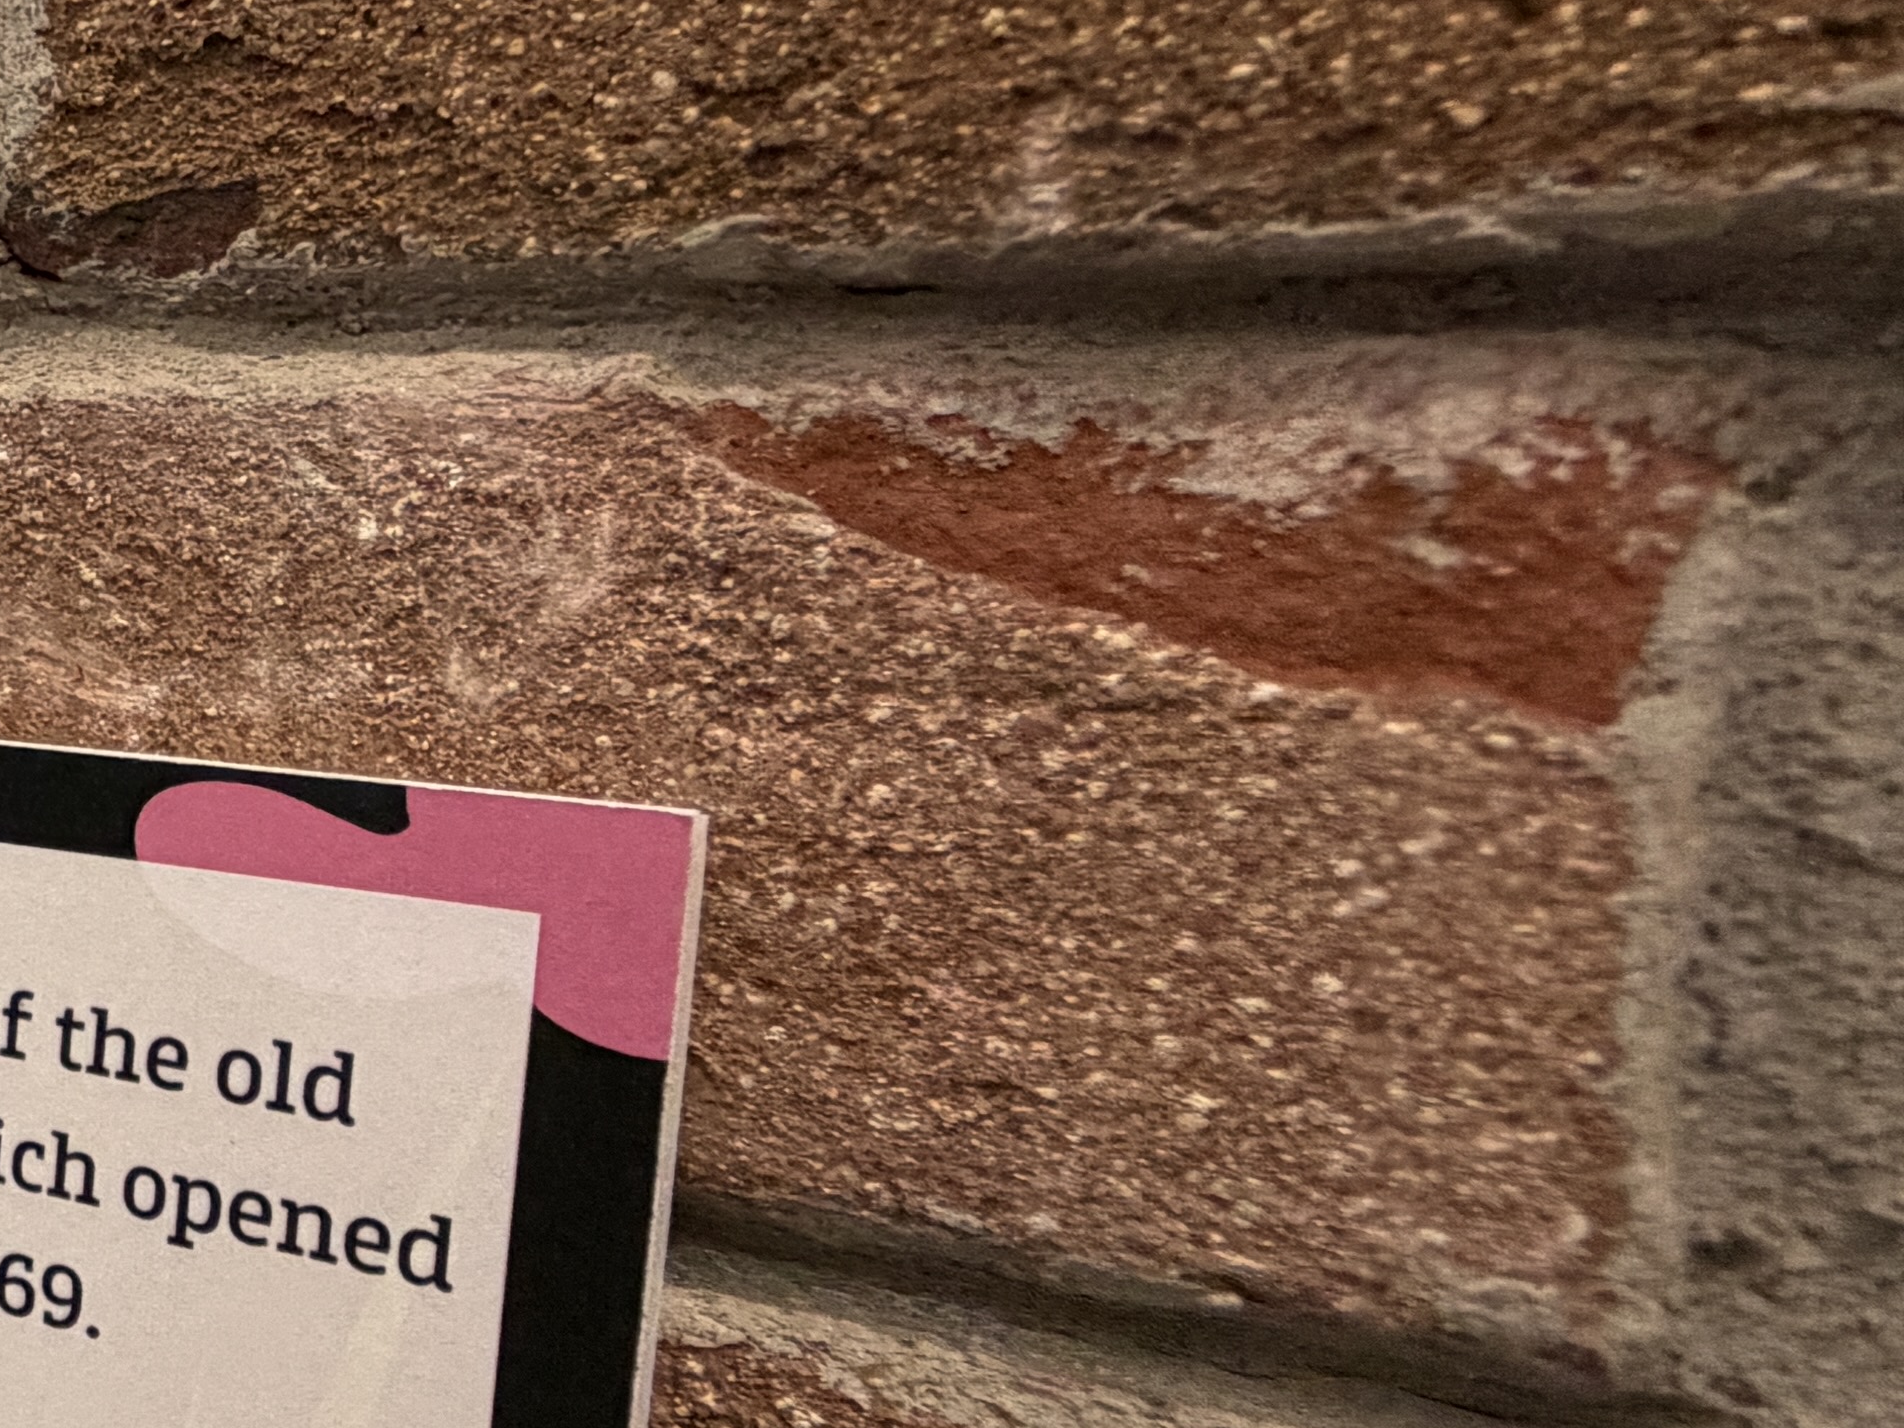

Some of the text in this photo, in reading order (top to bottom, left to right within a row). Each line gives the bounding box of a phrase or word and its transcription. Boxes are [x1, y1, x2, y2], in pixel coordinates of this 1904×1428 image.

[53, 1004, 191, 1093] the
[215, 1037, 357, 1129] old
[121, 1164, 455, 1295] opened
